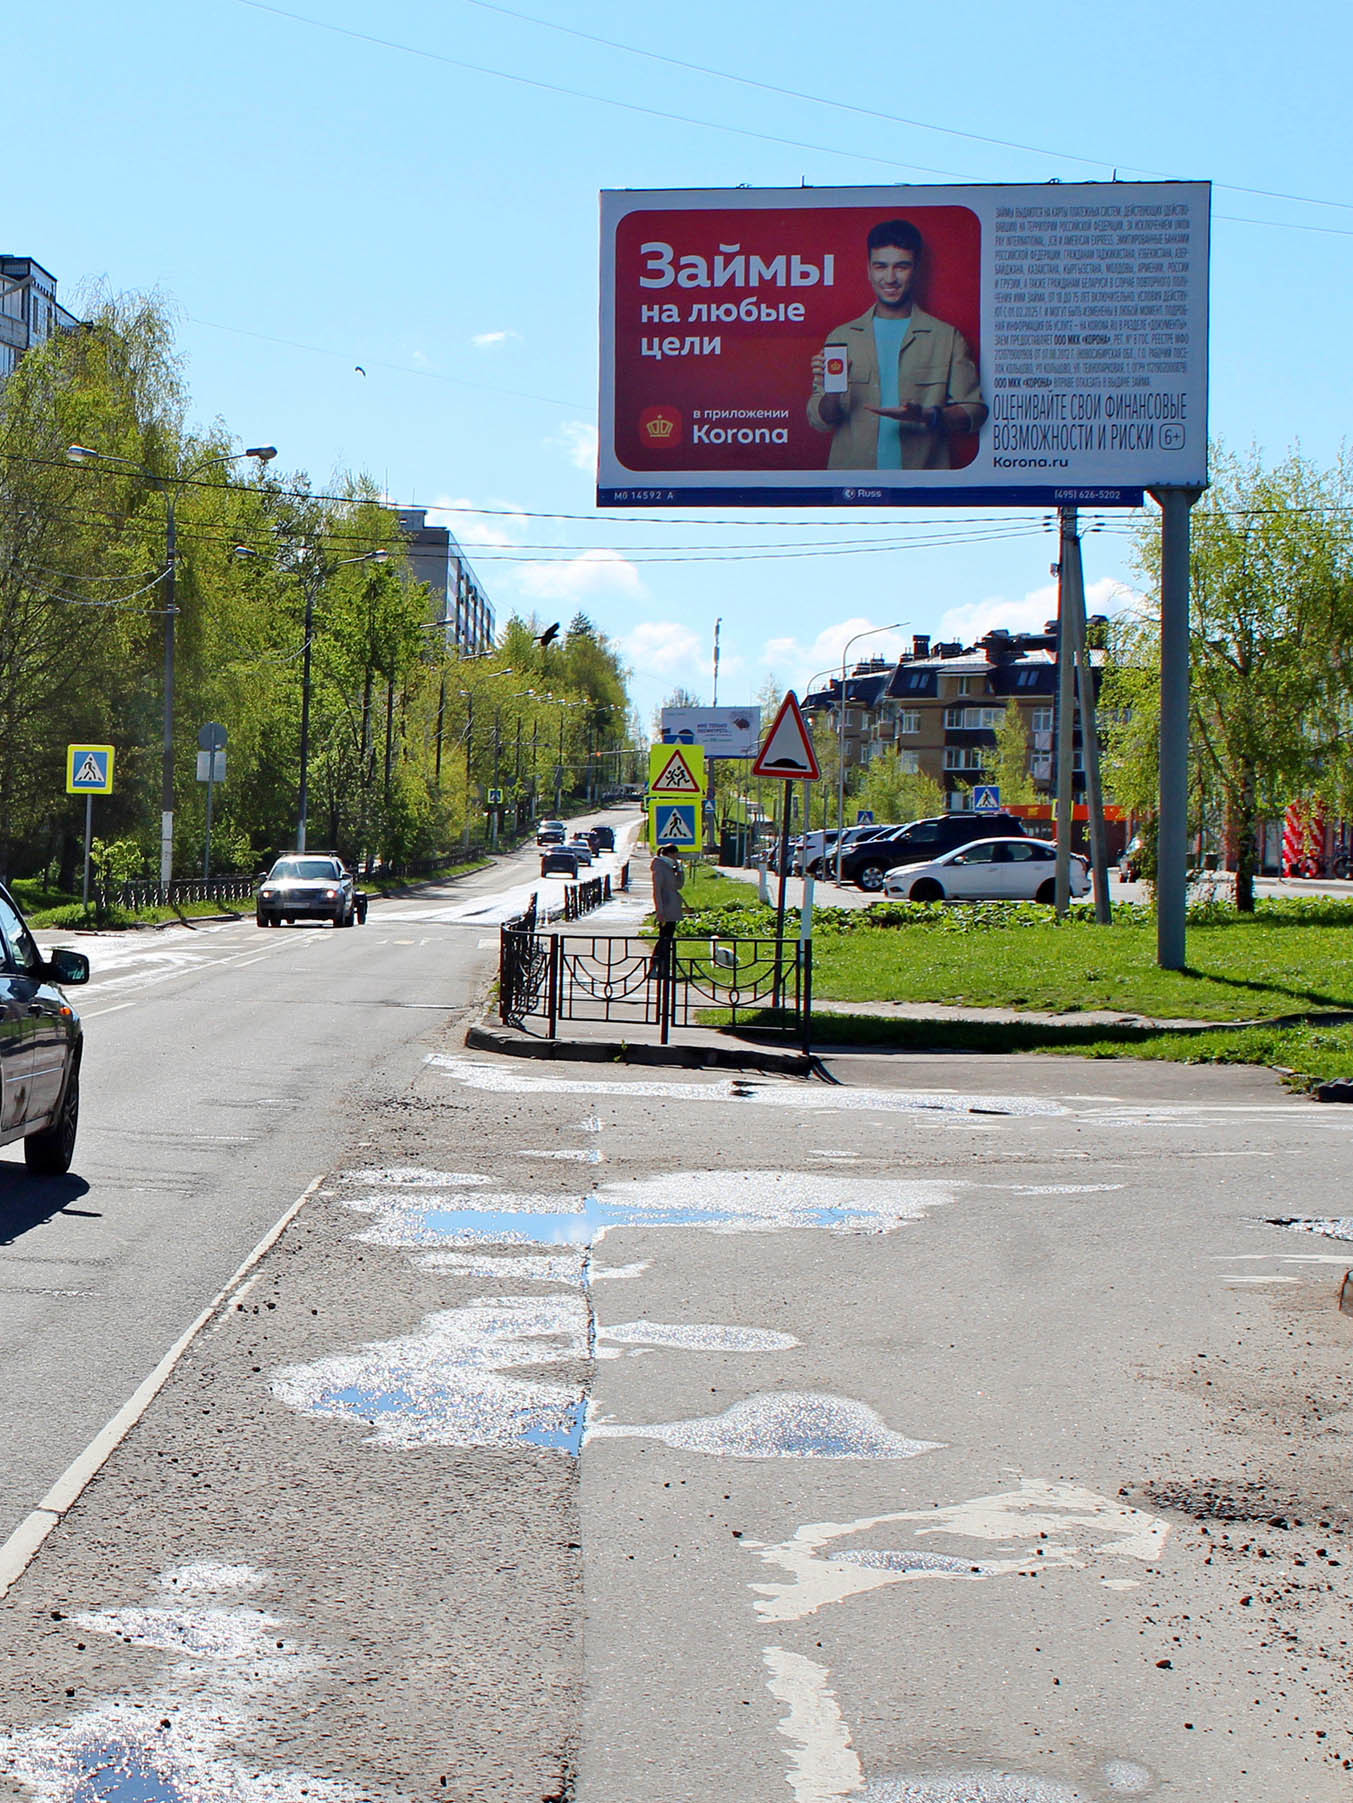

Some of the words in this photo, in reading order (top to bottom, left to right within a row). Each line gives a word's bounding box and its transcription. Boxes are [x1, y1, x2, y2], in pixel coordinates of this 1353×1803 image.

[638, 241, 835, 289] Займы
[640, 303, 680, 323] на
[688, 297, 806, 323] любые
[640, 336, 722, 360] цели
[692, 410, 701, 419] в
[703, 408, 790, 421] приложении
[993, 390, 1067, 425] ОЦЕНИВАЙТЕ
[1070, 394, 1101, 421] СВОИ
[1104, 392, 1187, 420] ФИНАНСОВЫЕ
[692, 424, 789, 445] Korona
[993, 423, 1093, 451] ВОЗМОЖНОСТИ
[1098, 423, 1106, 451] И
[1110, 423, 1154, 450] РИСКИ
[1163, 428, 1181, 446] 6+
[993, 456, 1069, 469] Korona.ru
